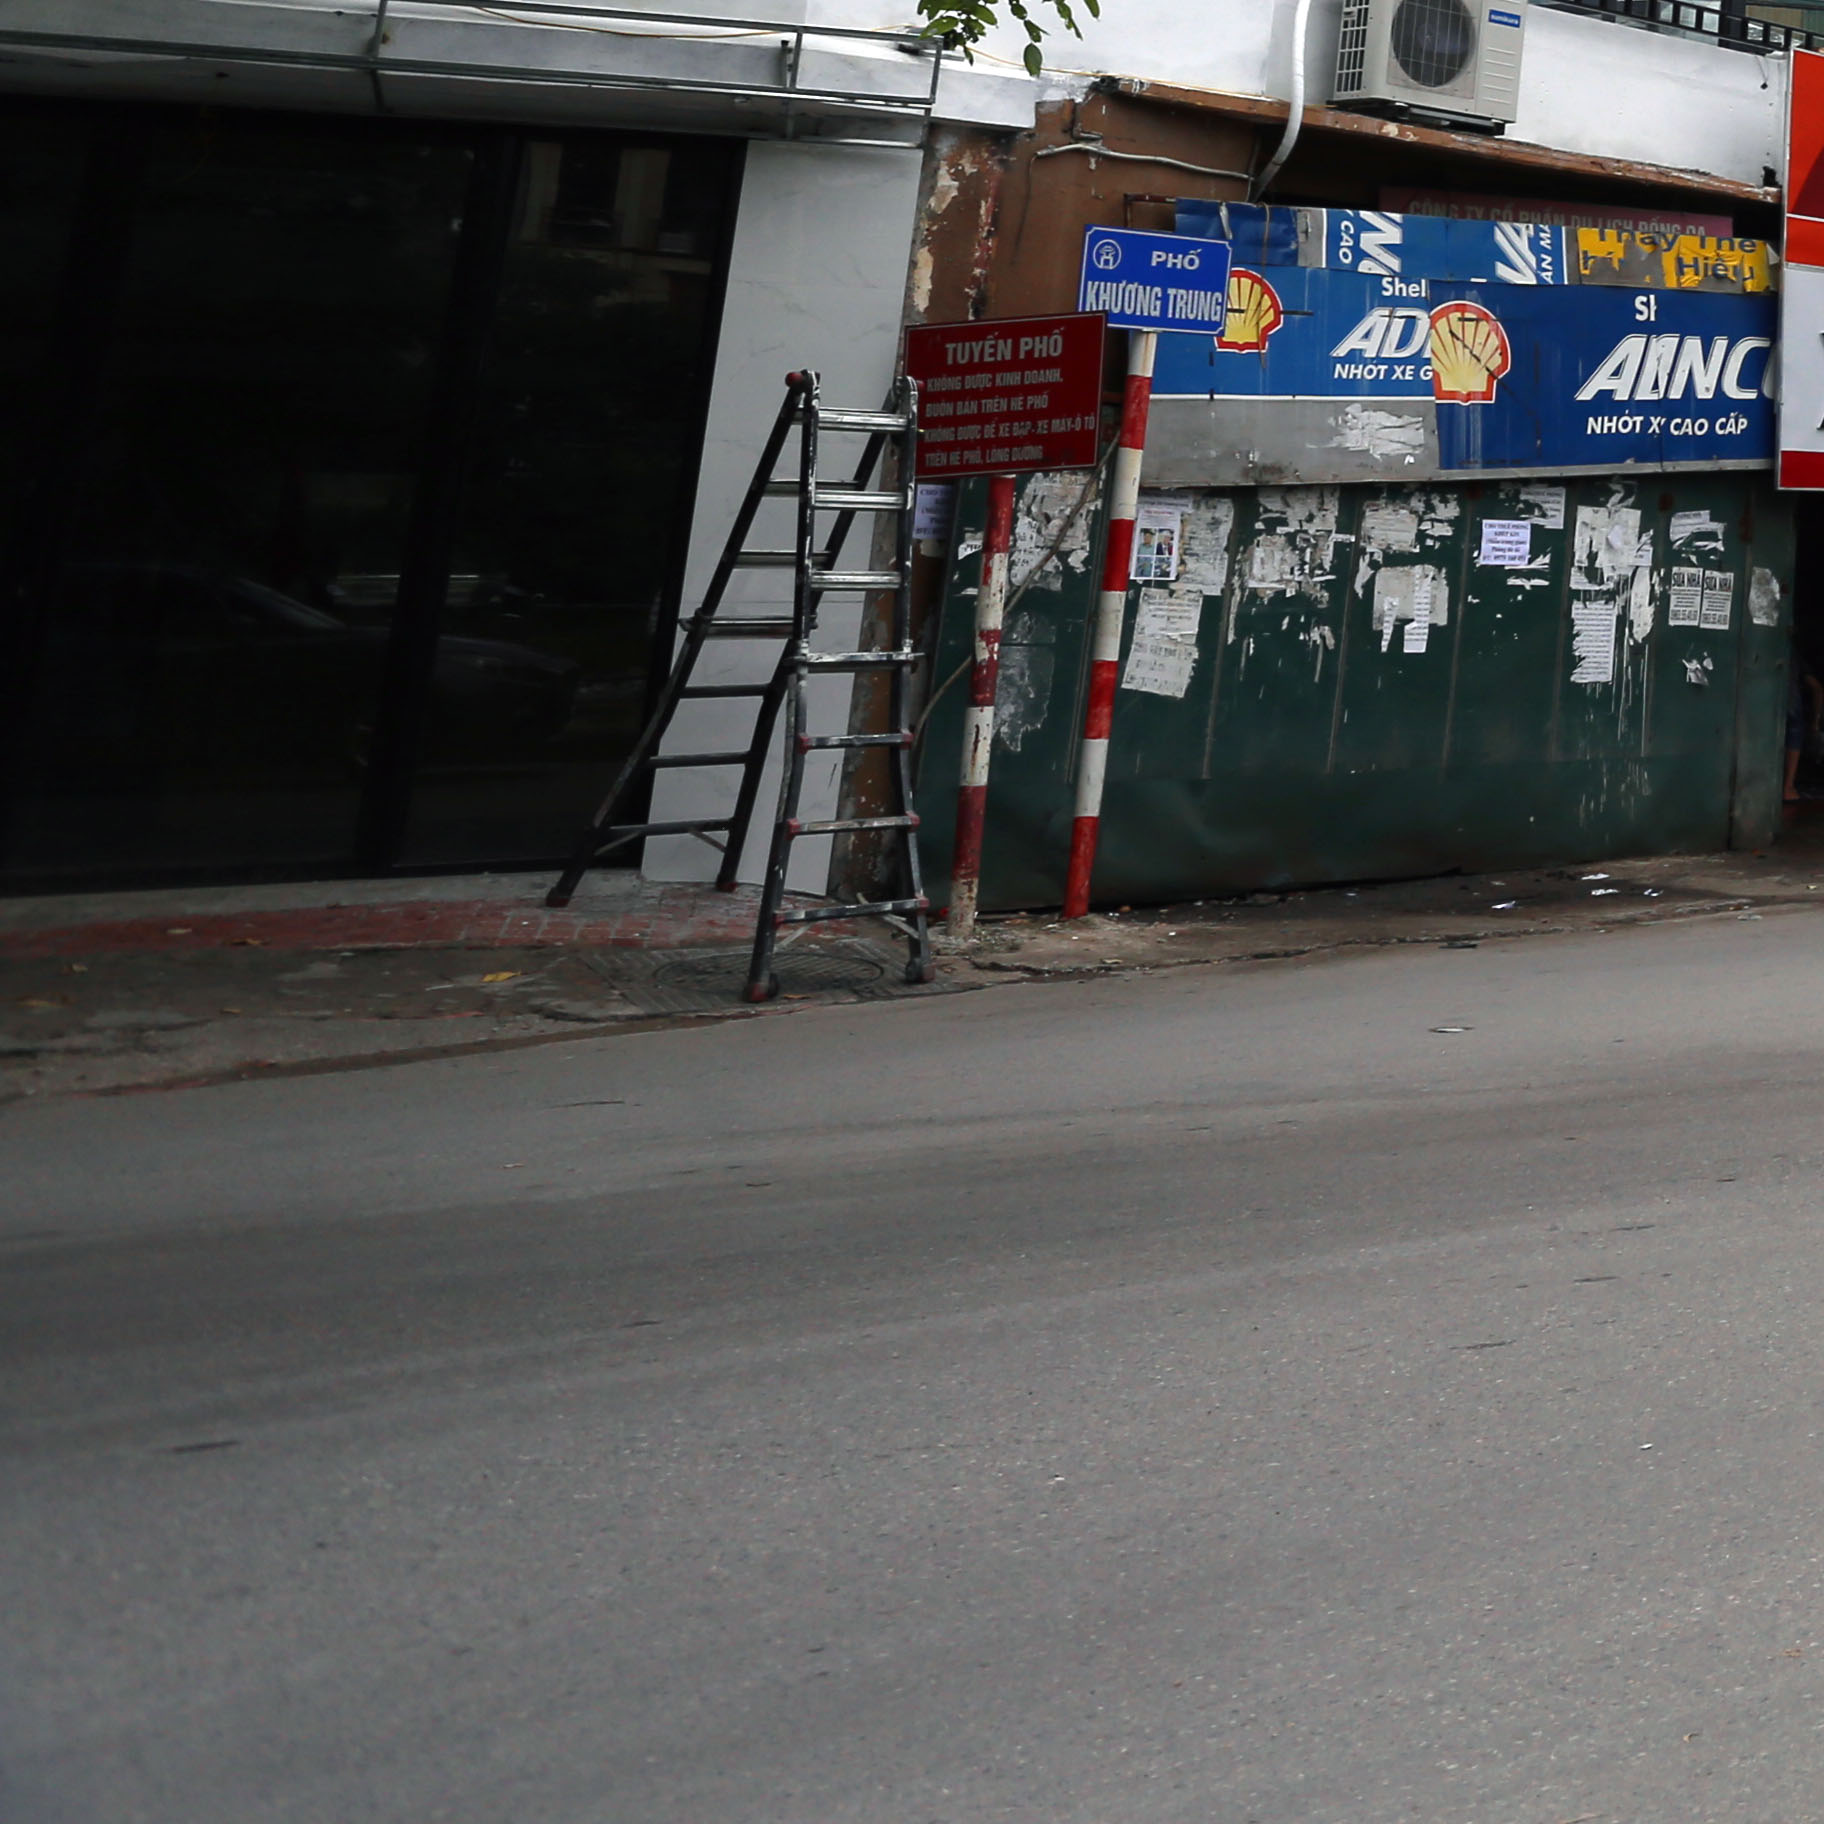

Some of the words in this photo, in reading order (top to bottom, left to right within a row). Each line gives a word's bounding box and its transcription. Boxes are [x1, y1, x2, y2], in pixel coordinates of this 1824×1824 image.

[1338, 220, 1355, 264] CAO
[1151, 249, 1202, 270] PHỐ
[1085, 280, 1161, 316] KHƯƠNG
[1167, 288, 1222, 322] TRUNG
[944, 331, 1013, 366] TUYẾN
[1020, 326, 1065, 360] PHỐ
[1334, 360, 1388, 380] NHỚT
[1391, 365, 1414, 380] XE
[1587, 409, 1643, 435] NHỚT
[1670, 418, 1708, 436] CAO
[1715, 412, 1748, 436] CẤP
